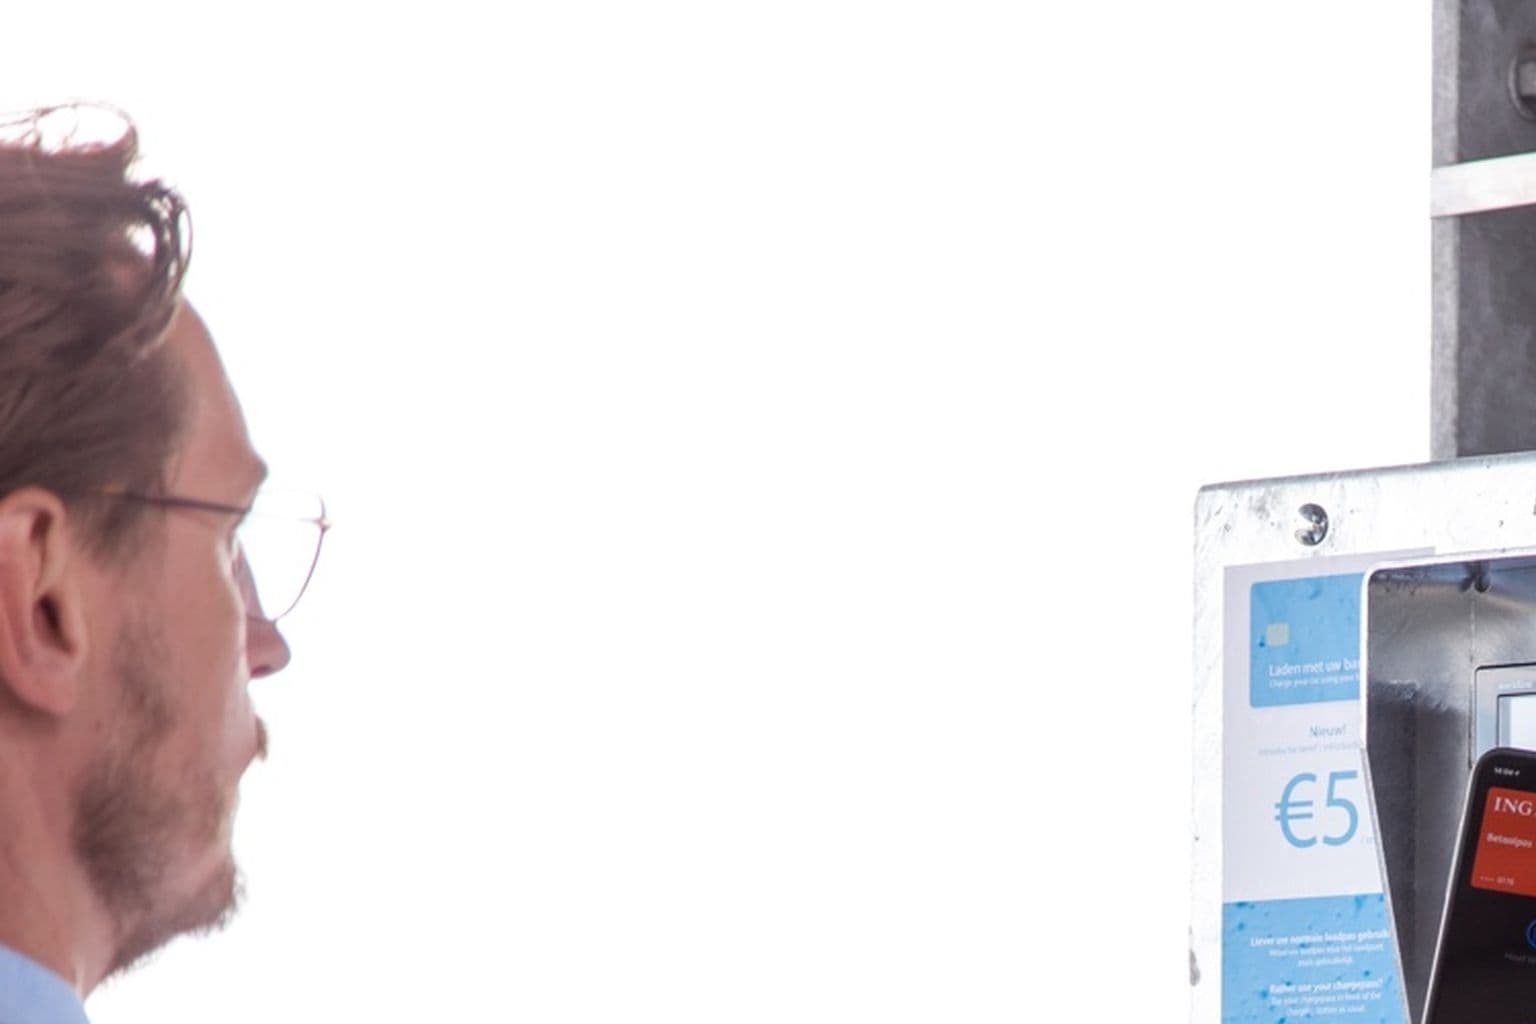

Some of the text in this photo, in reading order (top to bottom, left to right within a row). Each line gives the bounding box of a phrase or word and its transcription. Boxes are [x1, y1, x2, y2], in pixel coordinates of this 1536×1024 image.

[1268, 662, 1301, 677] Laden
[1302, 661, 1324, 673] met
[1325, 661, 1342, 672] uw
[1308, 723, 1346, 738] Nieuw!
[1493, 796, 1534, 816] ING
[1276, 936, 1288, 945] uw
[1289, 933, 1323, 944] normale
[1312, 982, 1332, 994] your
